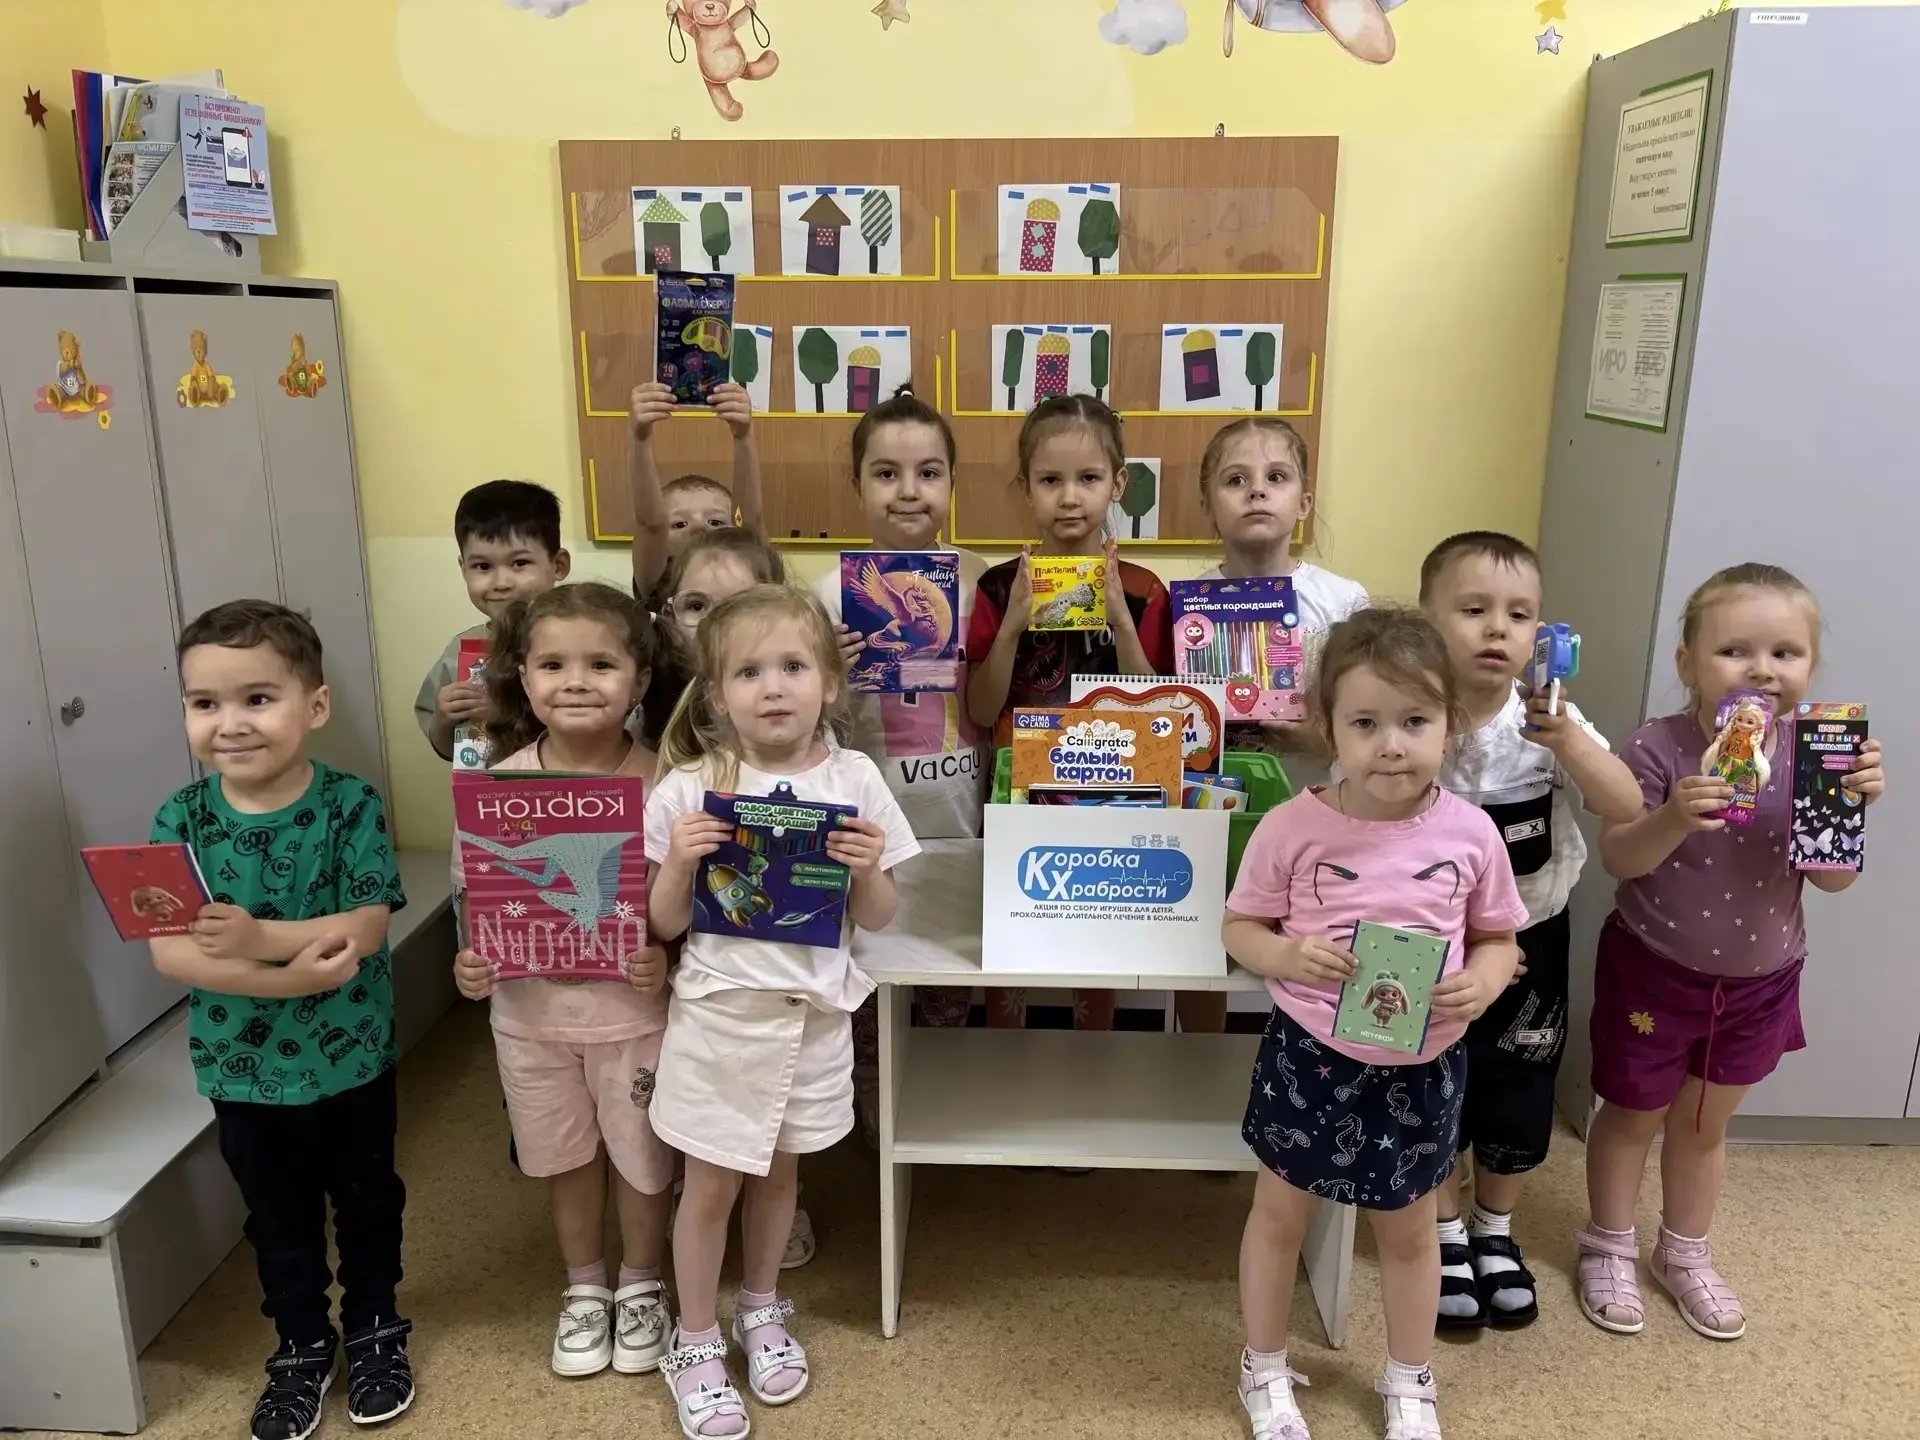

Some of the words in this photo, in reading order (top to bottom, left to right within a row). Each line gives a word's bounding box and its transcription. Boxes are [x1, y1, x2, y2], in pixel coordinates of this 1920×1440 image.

[184, 107, 223, 121] ТЕЛЕФОННЫЕ
[912, 569, 956, 583] Fantasy
[1183, 596, 1209, 604] набор
[1183, 602, 1222, 611] цветных
[1222, 600, 1285, 611] карандашей
[1030, 714, 1050, 722] SIMA
[1151, 720, 1170, 734] 3+
[1818, 724, 1847, 733] НАБОР
[1067, 730, 1129, 749] Calligrata
[1802, 732, 1861, 744] ЦВЕТНЫХ
[1050, 747, 1120, 765] белый
[1056, 766, 1132, 784] картон
[734, 801, 772, 815] НАБОР
[773, 806, 827, 821] ЦВЕТНЫХ
[741, 814, 818, 831] КАРАНДАШЕЙ
[1024, 849, 1140, 891] Коробка
[1046, 870, 1168, 900] Храбрости
[1033, 904, 1059, 912] АКЦИЯ
[1073, 904, 1099, 912] СБОРУ
[1100, 905, 1133, 913] ИГРУШЕК
[1151, 905, 1175, 914] ДЕТЕЙ,
[1010, 911, 1064, 919] ПРОХОДЯЩИХ
[1065, 912, 1113, 920] ДЛИТЕЛЬНОЕ
[1153, 915, 1200, 923] БОЛЬНИЦАХ
[1360, 1029, 1395, 1043] NOTEBOOK
